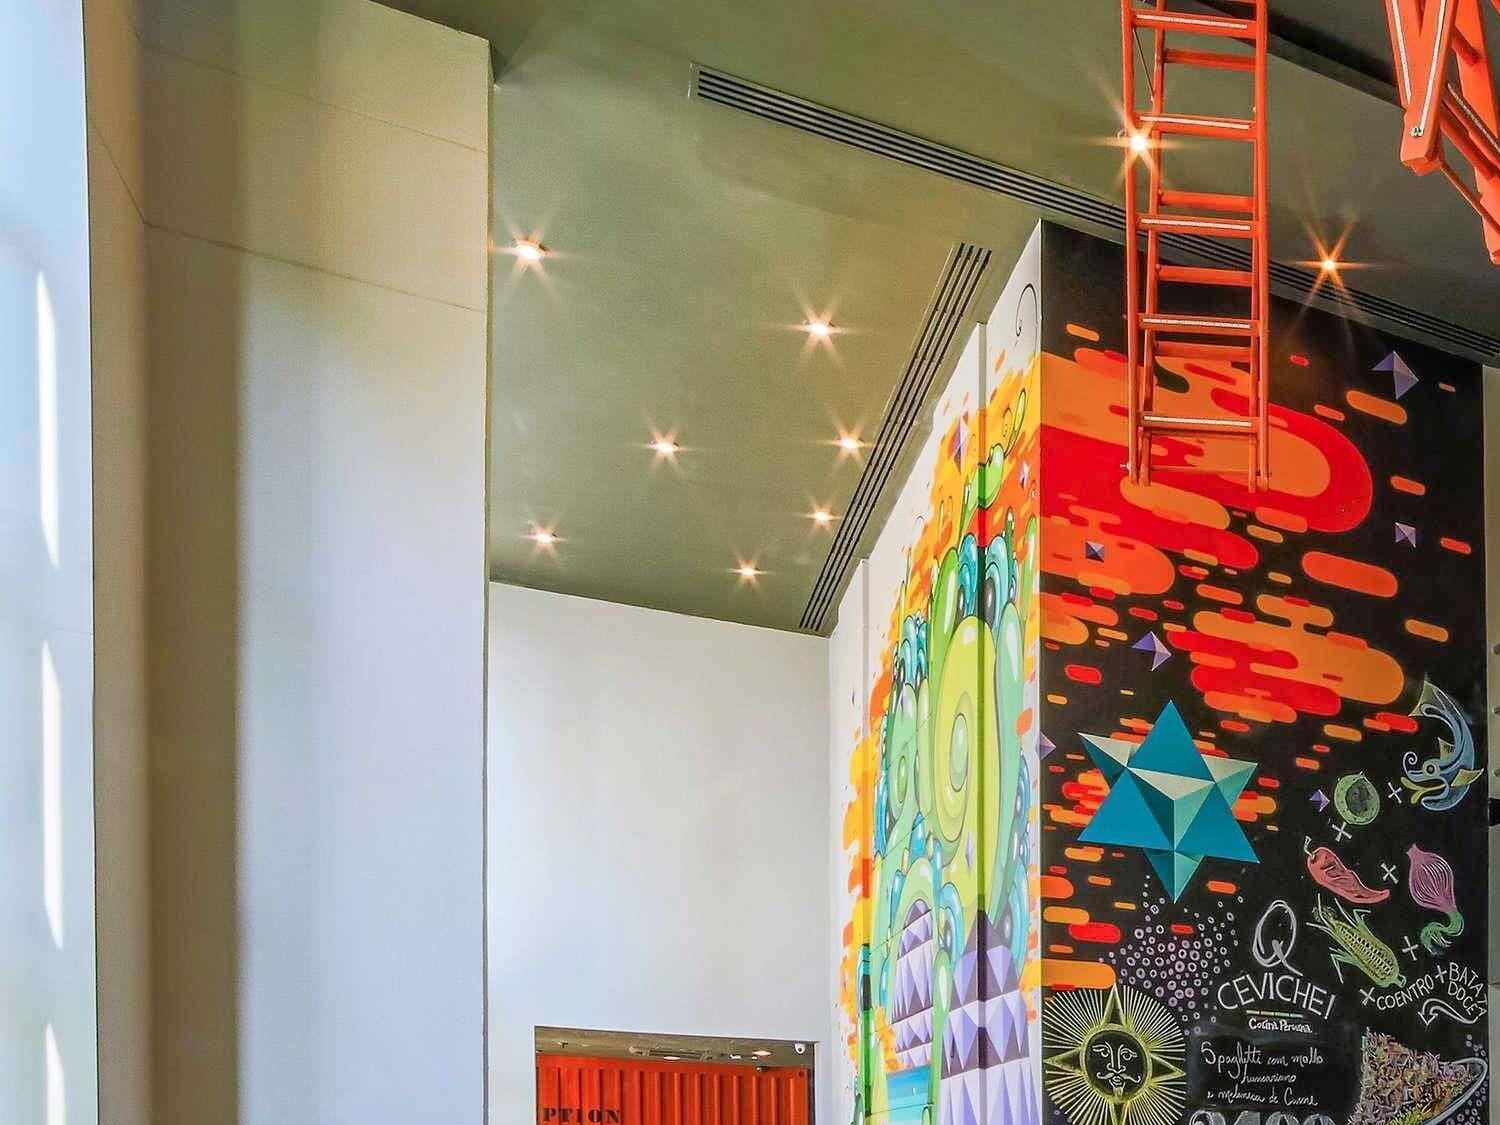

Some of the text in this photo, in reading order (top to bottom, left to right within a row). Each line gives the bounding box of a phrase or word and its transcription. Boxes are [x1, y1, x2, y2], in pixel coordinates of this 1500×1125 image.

[1217, 972, 1336, 1020] CEVICHE!
[1376, 962, 1488, 1018] COENTRO BATATA
[1447, 981, 1478, 1016] DOCE
[1200, 1041, 1262, 1080] Spaghetti
[542, 1107, 621, 1124] PTION
